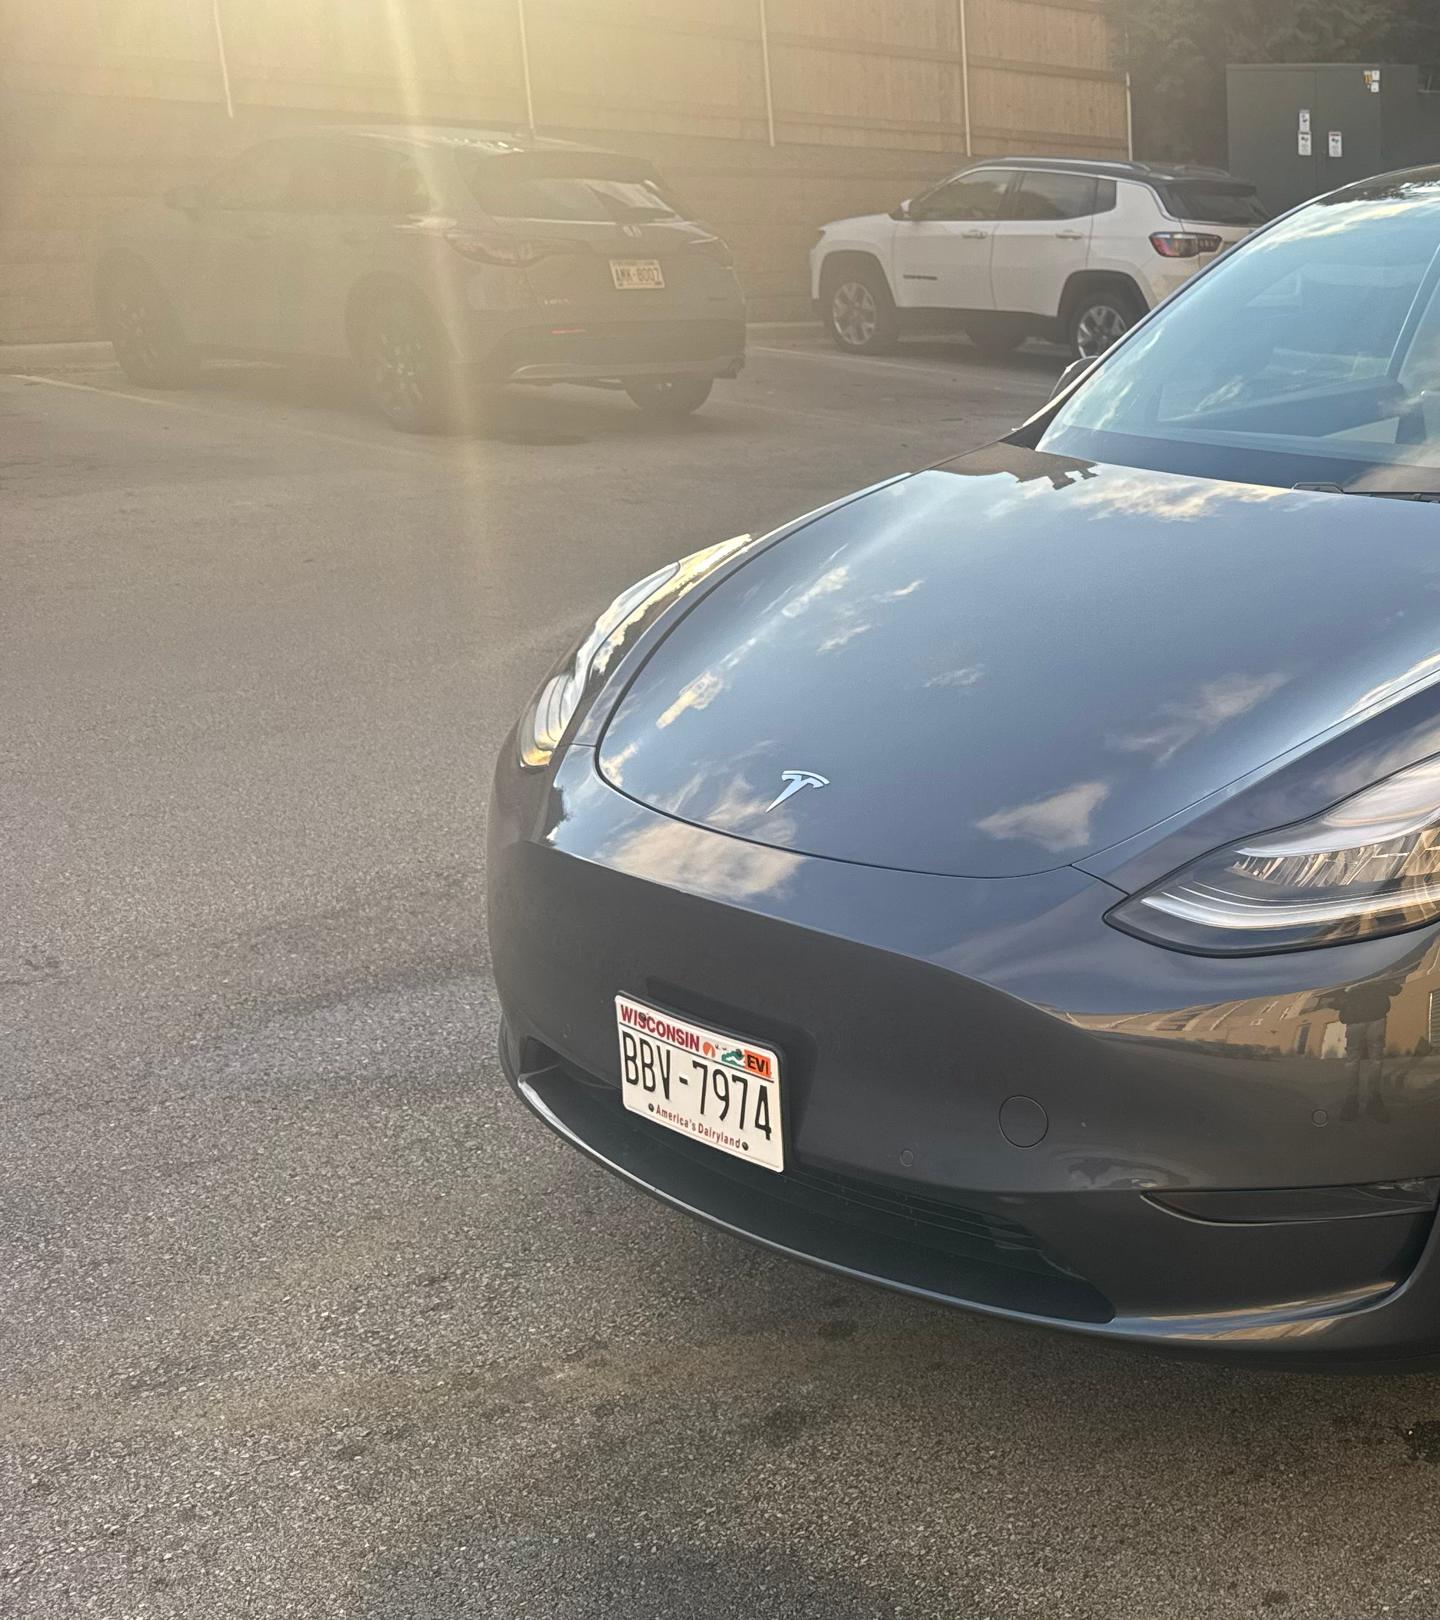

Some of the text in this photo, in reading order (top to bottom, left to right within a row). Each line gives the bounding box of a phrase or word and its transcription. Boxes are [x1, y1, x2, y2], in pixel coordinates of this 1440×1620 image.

[620, 1004, 700, 1052] WISCONSIN
[622, 1030, 772, 1141] BBV-7974
[656, 1104, 740, 1149] America's Dairyland
